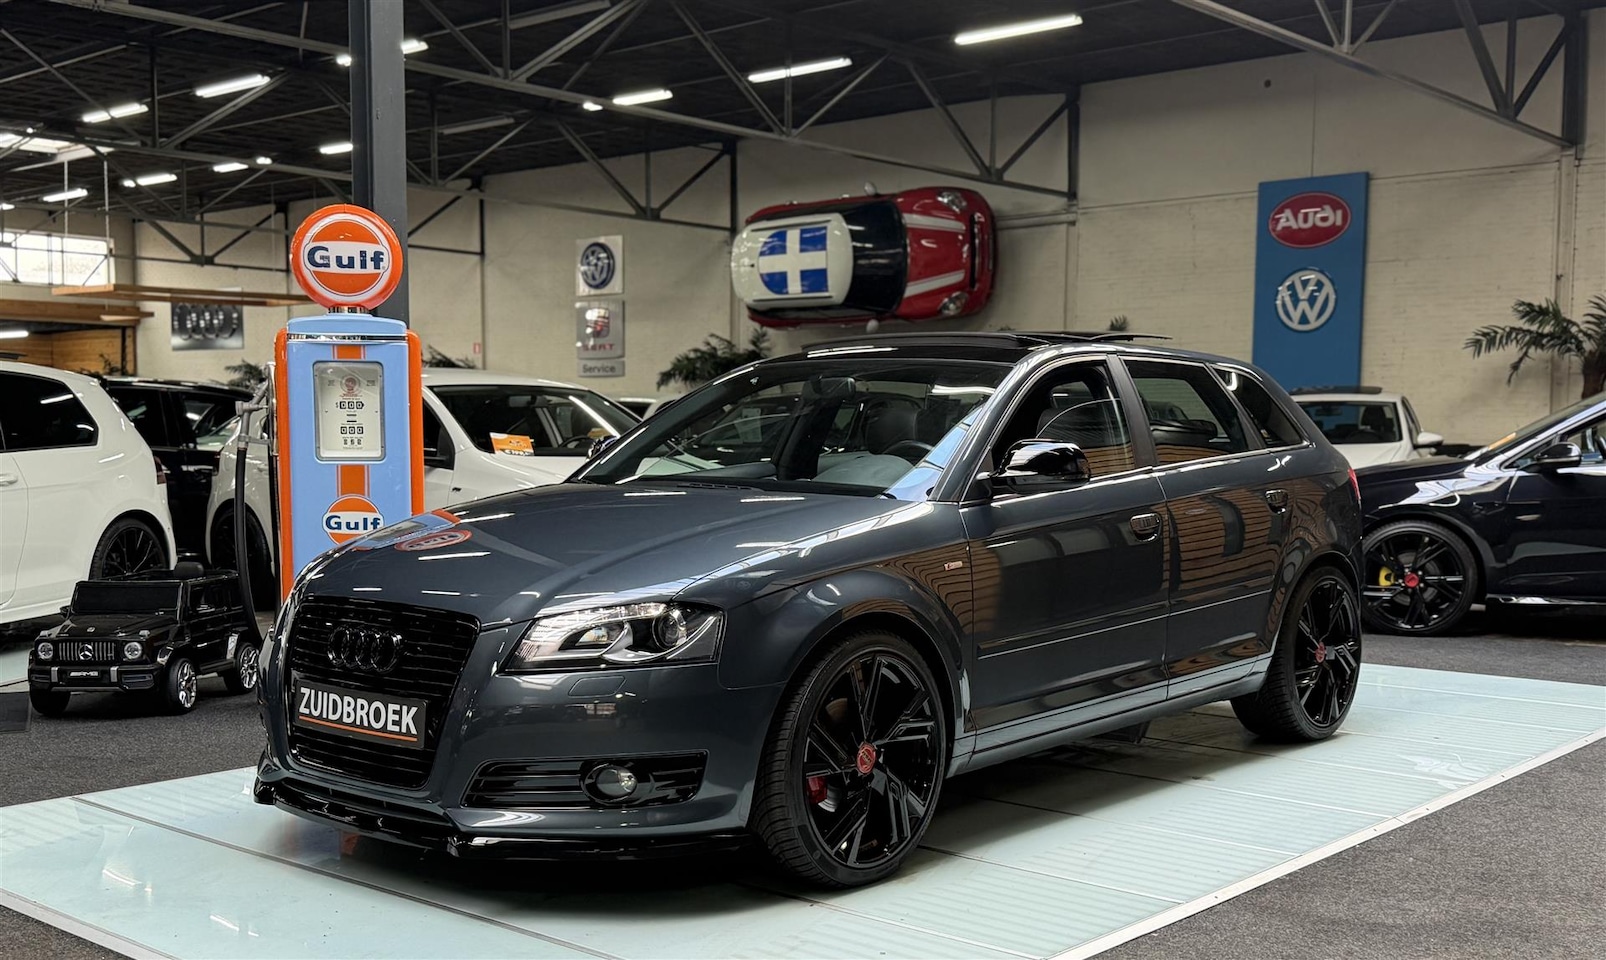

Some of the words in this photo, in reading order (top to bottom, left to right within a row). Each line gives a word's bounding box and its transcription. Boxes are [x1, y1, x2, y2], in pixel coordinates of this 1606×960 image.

[307, 245, 385, 270] Gulf
[582, 364, 616, 373] Service
[325, 514, 381, 531] Gulf
[298, 686, 419, 735] ZUIDBROEK
